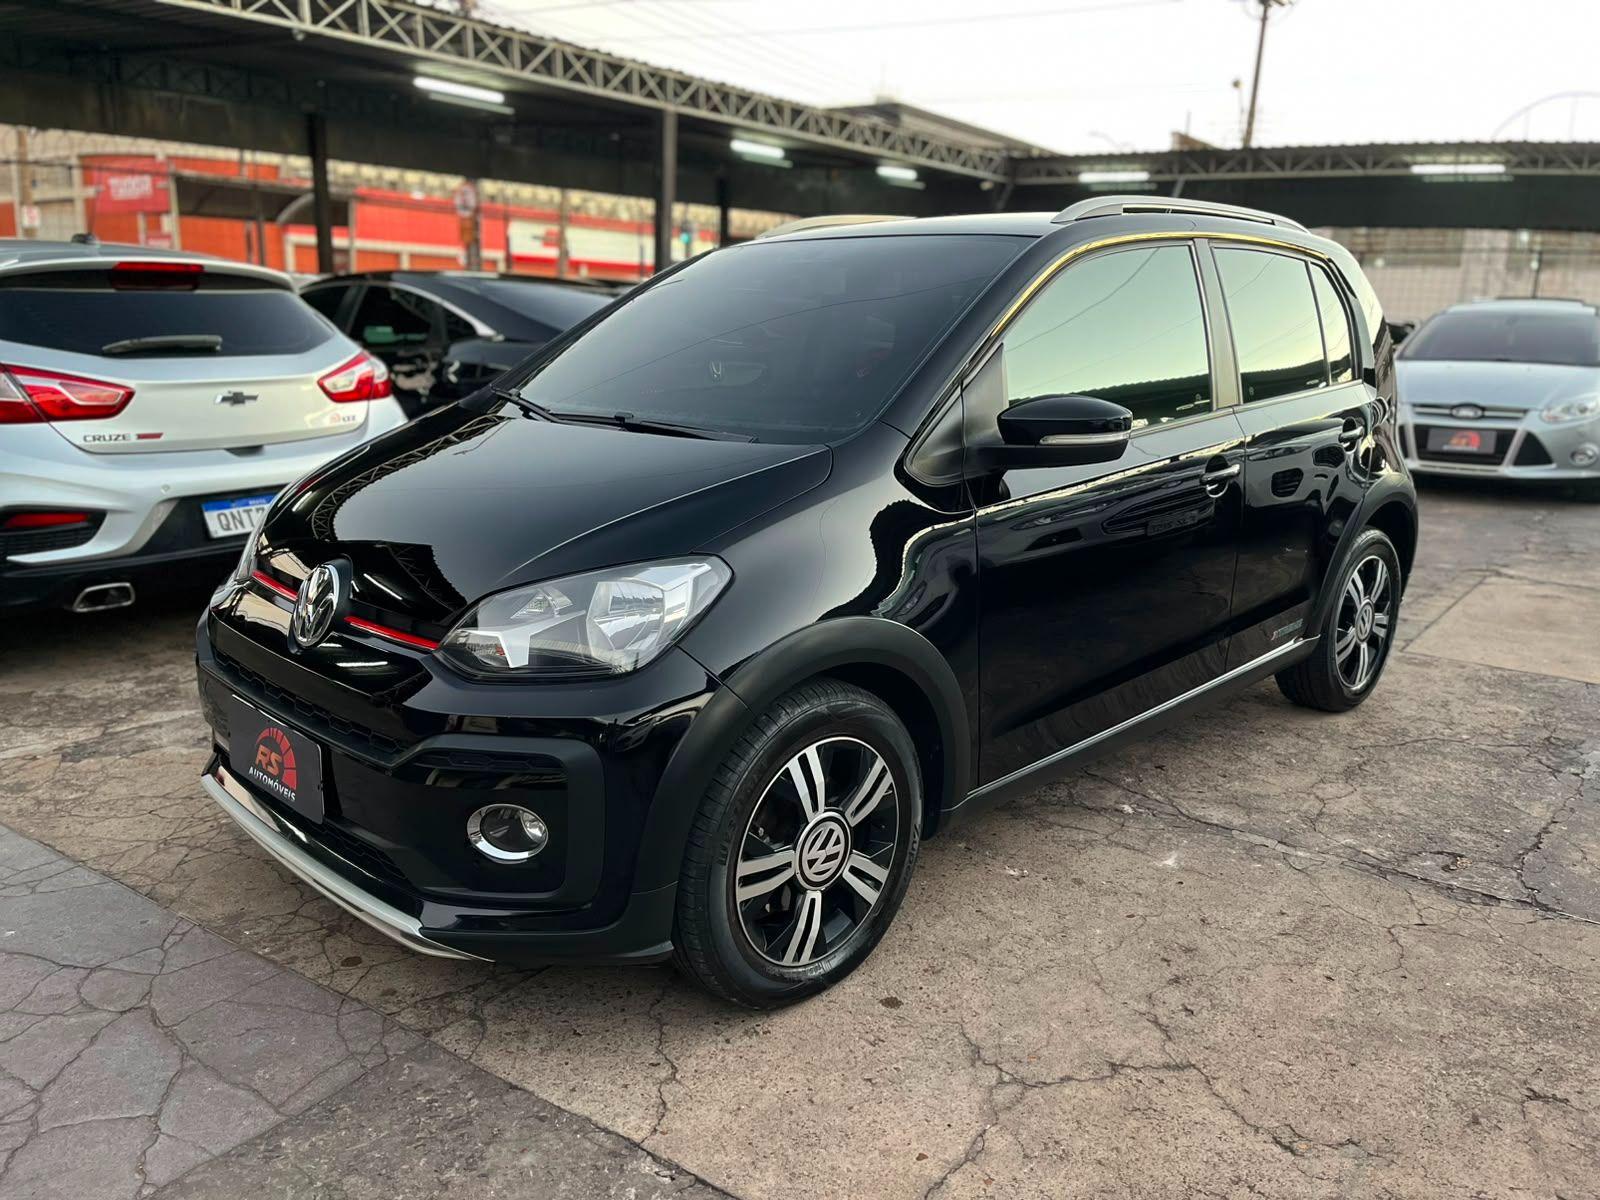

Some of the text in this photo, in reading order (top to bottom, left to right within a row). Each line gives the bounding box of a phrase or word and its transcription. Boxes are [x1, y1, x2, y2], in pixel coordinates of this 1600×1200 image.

[83, 434, 130, 442] CRUZE
[255, 743, 282, 776] RS
[248, 766, 296, 802] AUTOMÓVEIS
[803, 821, 845, 882] VW
